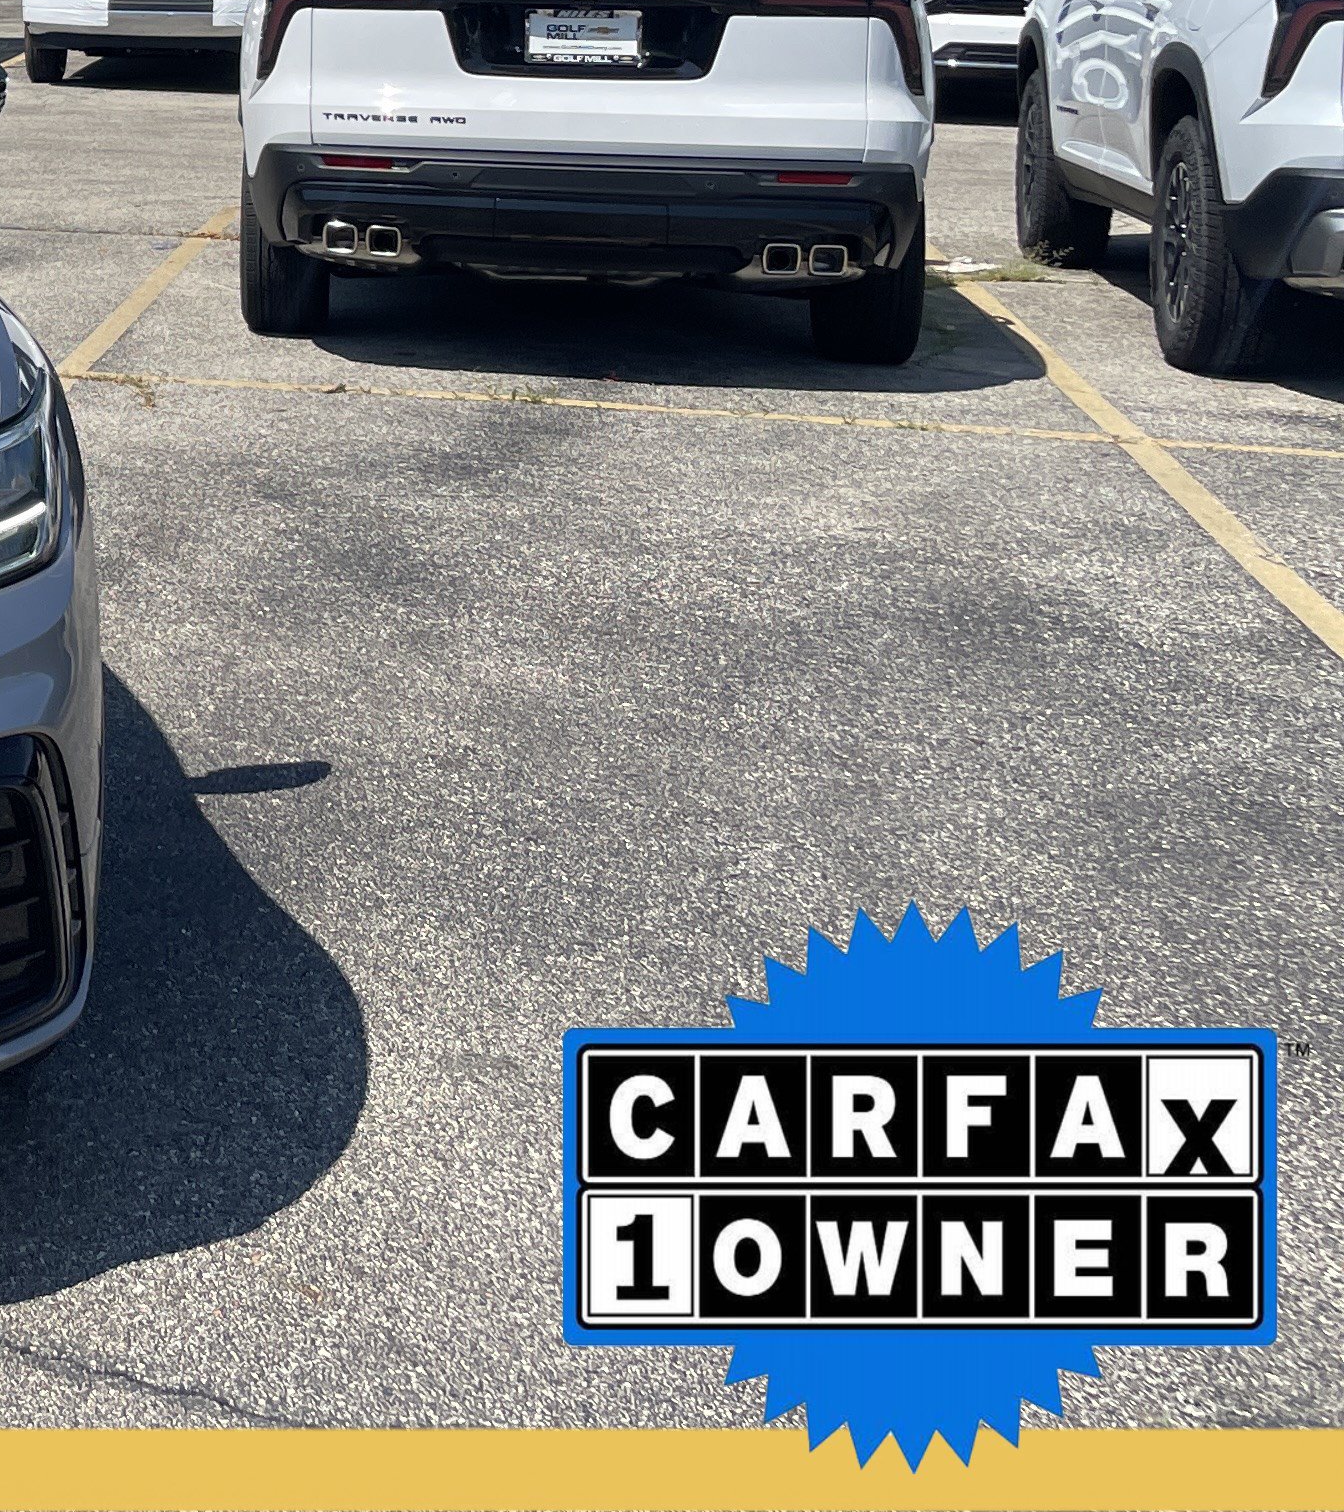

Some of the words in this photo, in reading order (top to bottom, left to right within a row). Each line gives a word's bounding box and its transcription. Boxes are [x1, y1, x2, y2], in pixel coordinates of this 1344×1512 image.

[546, 24, 587, 33] GOLF
[546, 32, 578, 40] MILL
[553, 54, 583, 63] GOLF
[584, 54, 612, 63] MILL
[429, 115, 467, 125] AWD
